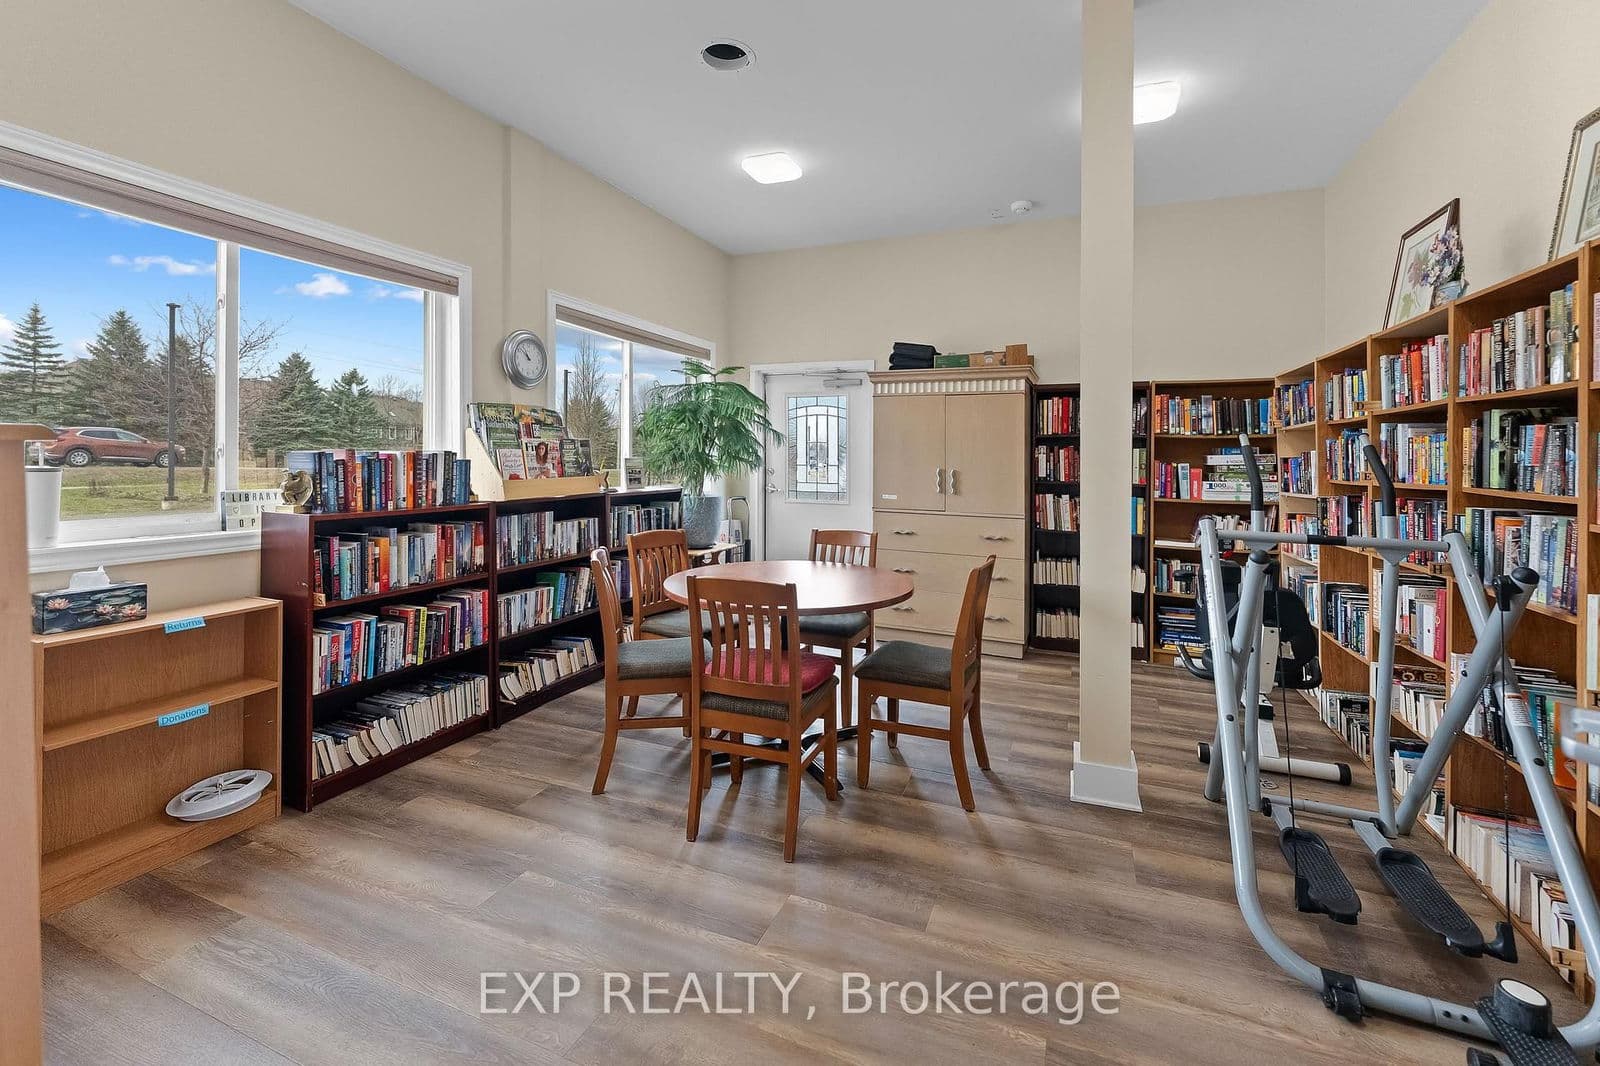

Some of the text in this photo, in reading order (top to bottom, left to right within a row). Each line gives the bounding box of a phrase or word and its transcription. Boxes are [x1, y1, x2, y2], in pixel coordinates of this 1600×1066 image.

[232, 493, 277, 502] LIBRARY
[240, 519, 256, 528] OP
[167, 619, 202, 631] Returns
[161, 706, 206, 725] Donations
